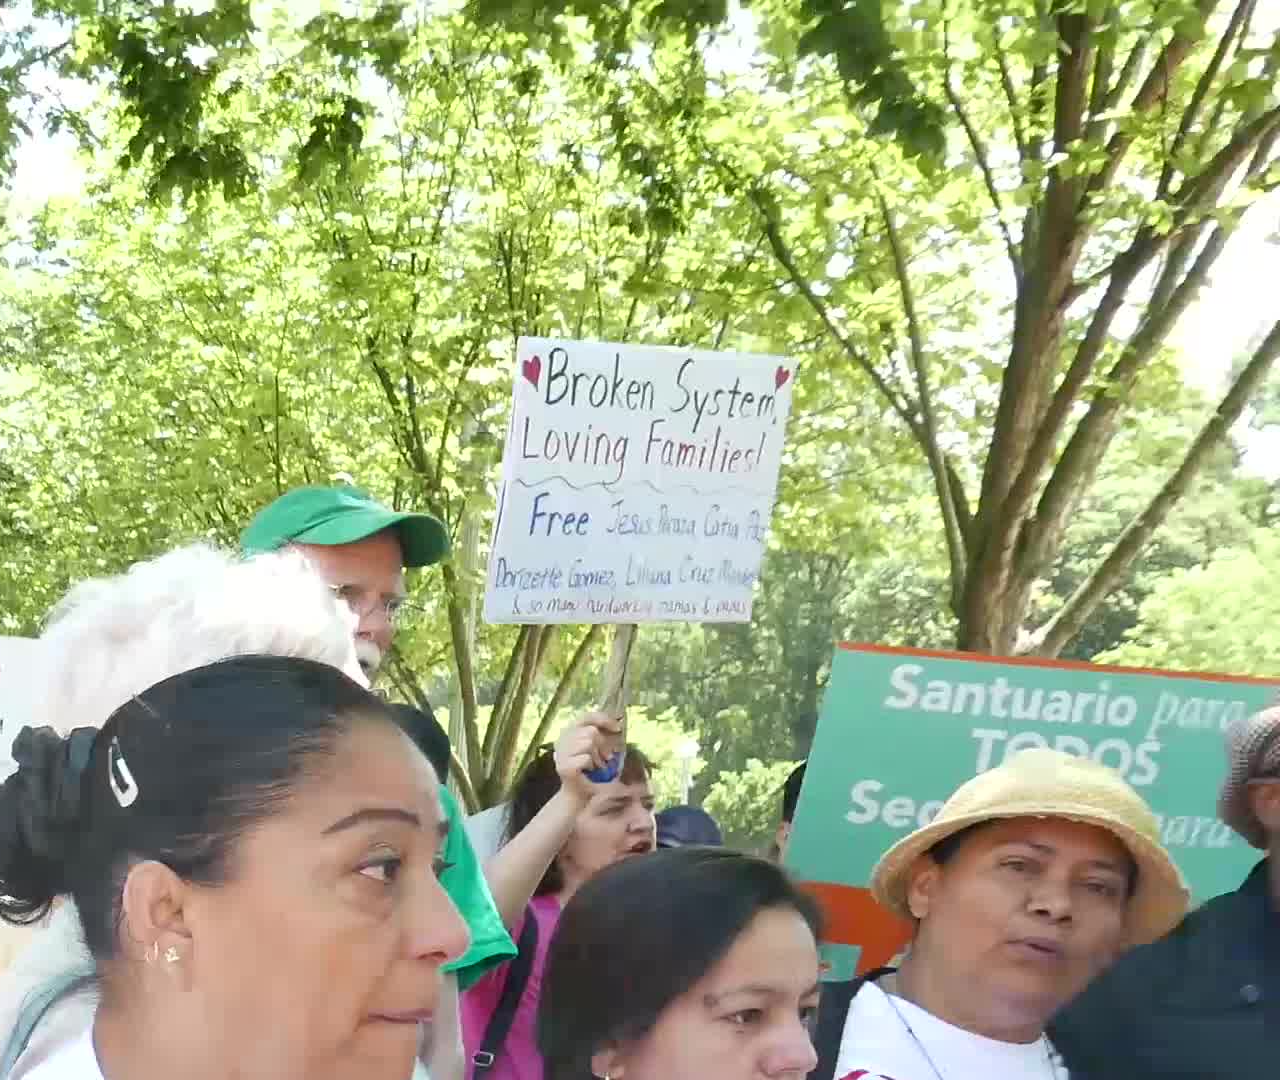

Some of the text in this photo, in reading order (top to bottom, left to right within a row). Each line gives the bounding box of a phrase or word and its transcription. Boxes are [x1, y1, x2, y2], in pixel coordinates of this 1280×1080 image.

[544, 347, 654, 410] Broken
[522, 416, 766, 482] Loving Families!
[529, 491, 590, 537] Free
[884, 664, 1248, 738] Santuario para
